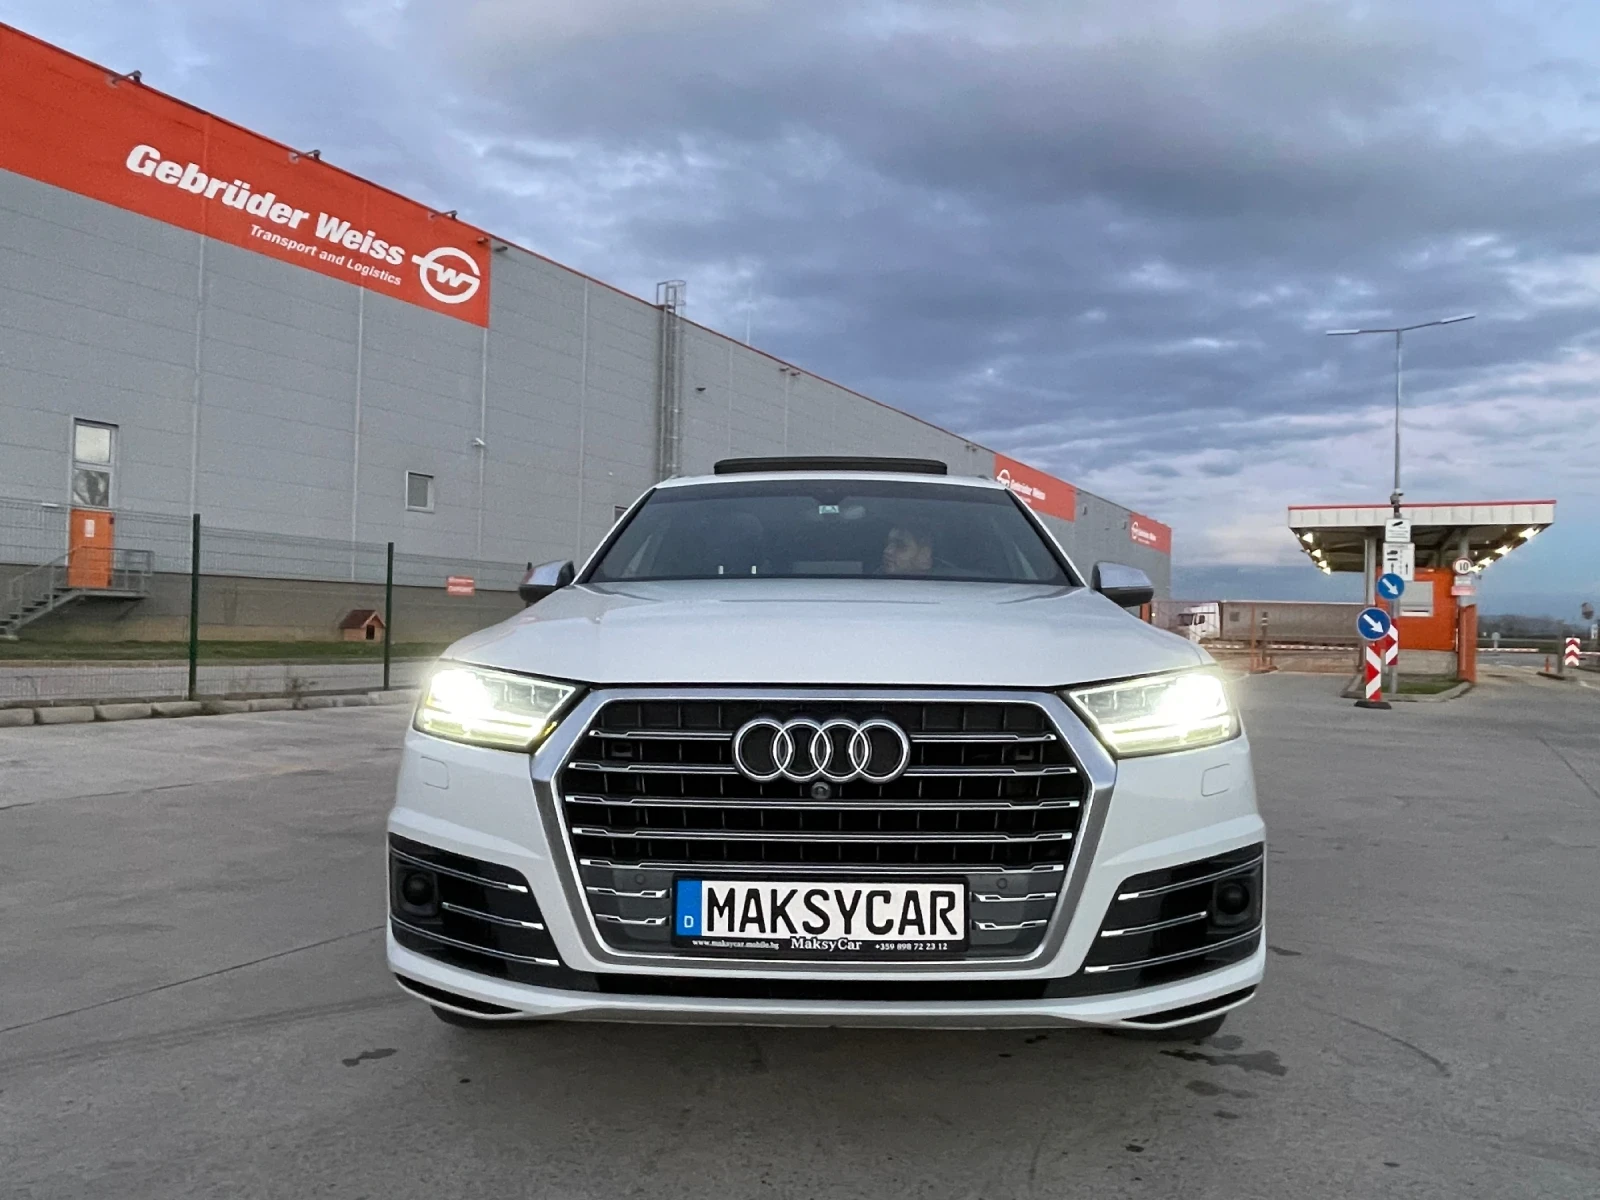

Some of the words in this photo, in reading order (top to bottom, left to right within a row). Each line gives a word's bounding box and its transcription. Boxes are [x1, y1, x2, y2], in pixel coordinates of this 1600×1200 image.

[126, 144, 310, 229] Gebrüder
[314, 212, 406, 265] Weiss
[250, 224, 318, 256] Transport
[319, 250, 345, 266] and
[347, 258, 402, 286] Logistics
[683, 915, 695, 929] D
[706, 887, 958, 935] MAKSYCAR
[790, 937, 863, 952] MaksyCar
[875, 942, 895, 951] +359
[913, 942, 924, 951] 72
[925, 942, 936, 951] 23
[938, 942, 948, 951] 12
